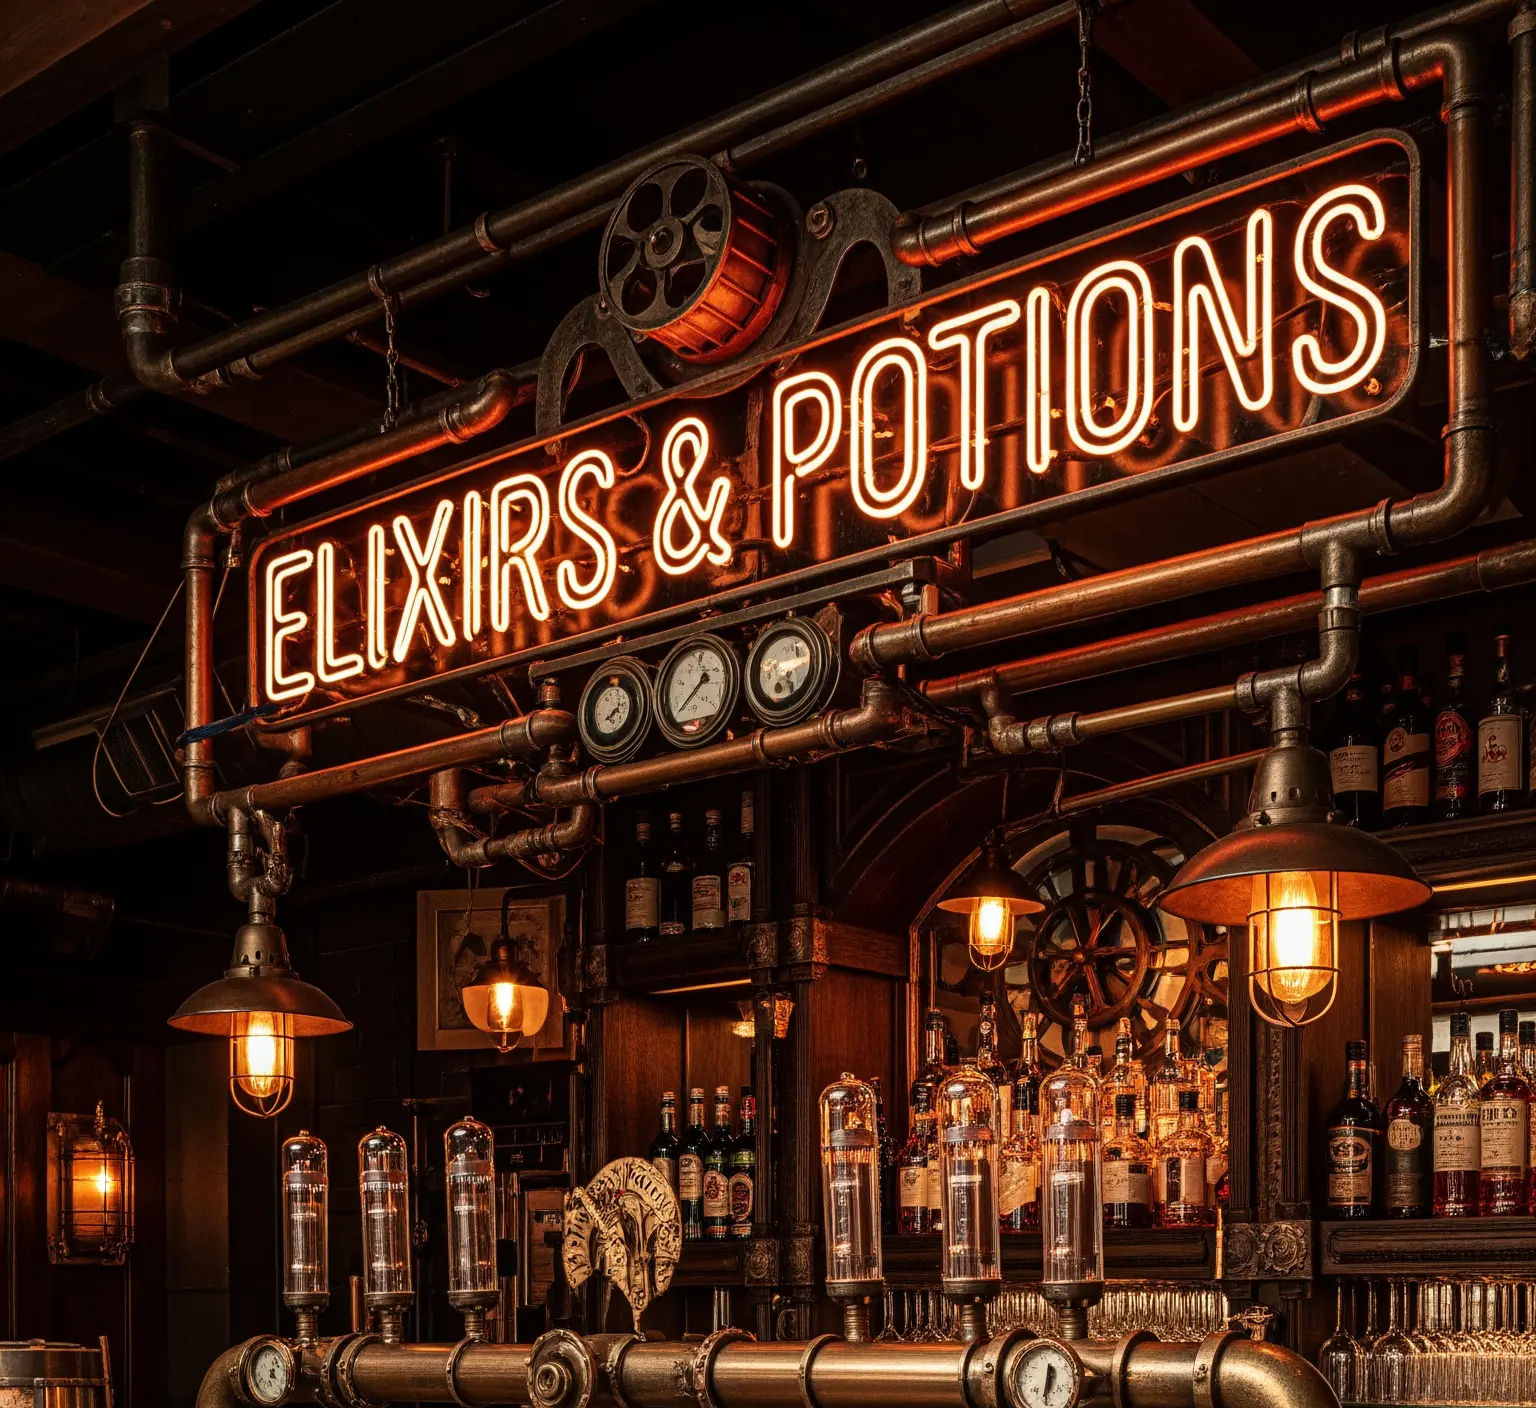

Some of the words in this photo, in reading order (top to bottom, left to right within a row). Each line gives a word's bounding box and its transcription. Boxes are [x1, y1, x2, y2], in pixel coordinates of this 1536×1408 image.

[264, 448, 618, 702] ELIXIRS
[652, 416, 733, 576] &
[772, 183, 1388, 550] POTIONS
